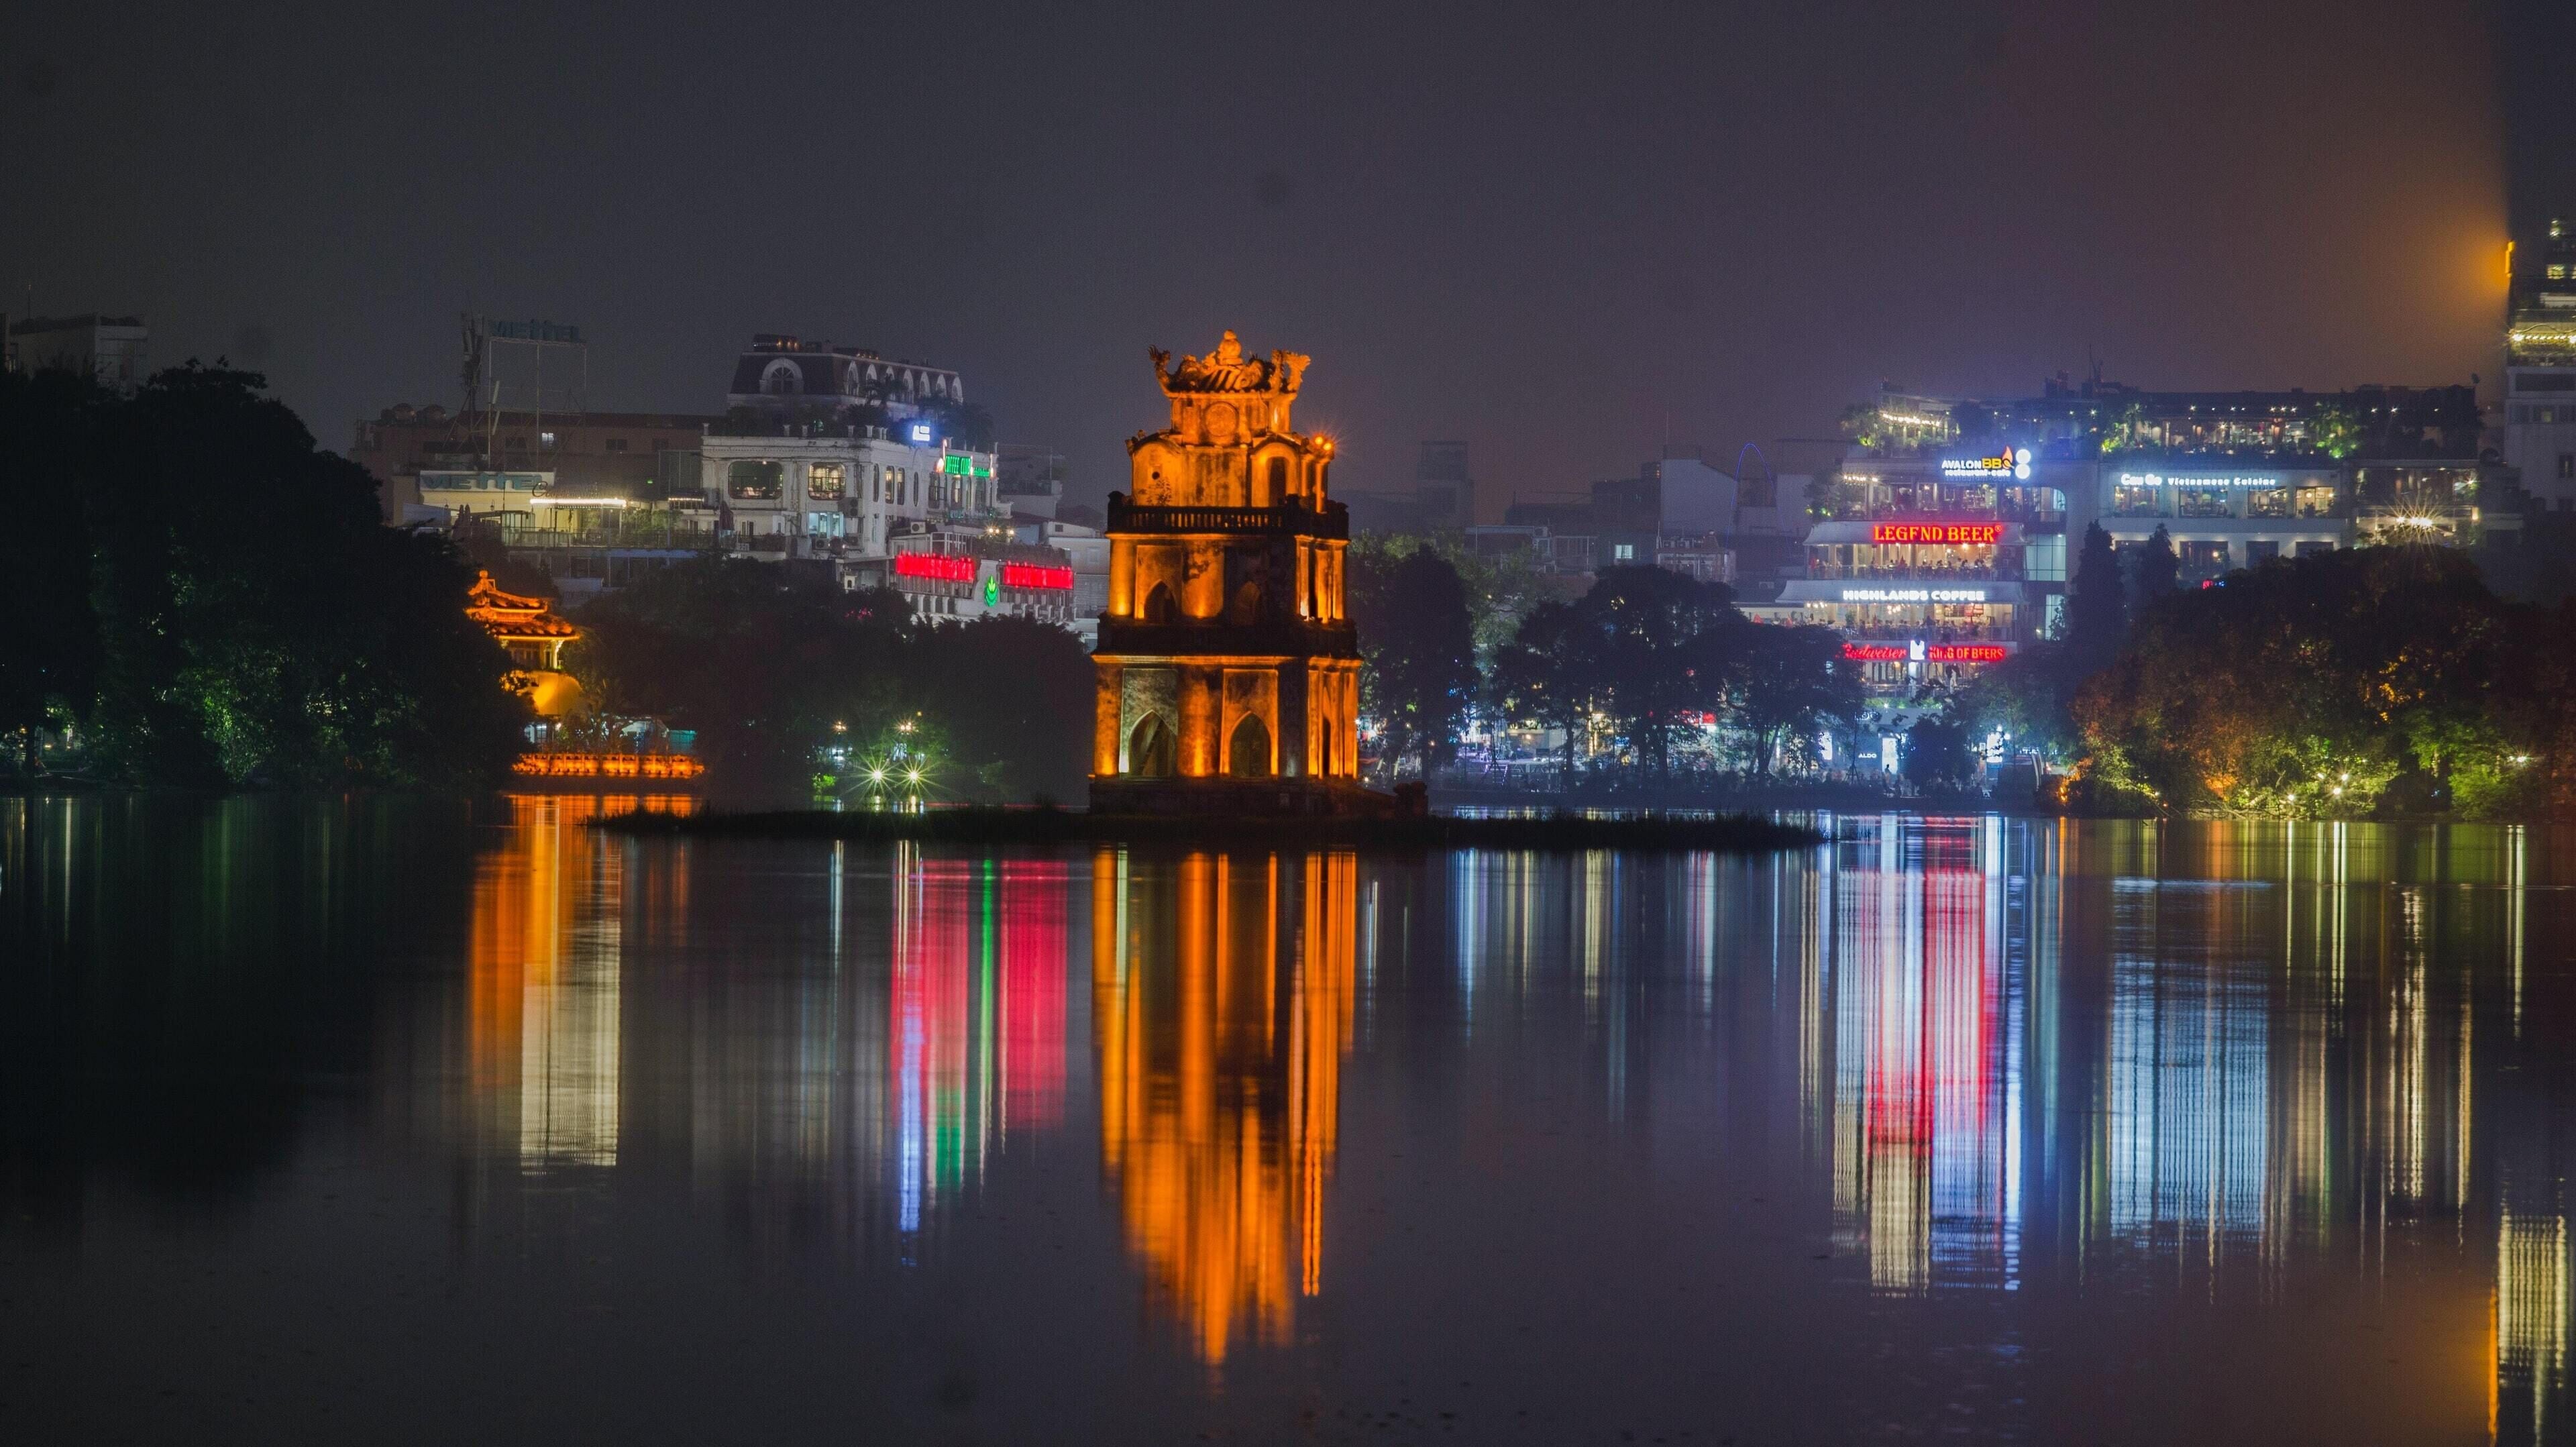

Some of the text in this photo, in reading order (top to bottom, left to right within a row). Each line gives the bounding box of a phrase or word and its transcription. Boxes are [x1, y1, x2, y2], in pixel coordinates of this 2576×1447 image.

[945, 455, 960, 474] COFFEE
[1941, 460, 1982, 469] AVALON
[1843, 590, 1985, 600] HIGHLANDS COFFEE
[1956, 647, 1970, 659] OF
